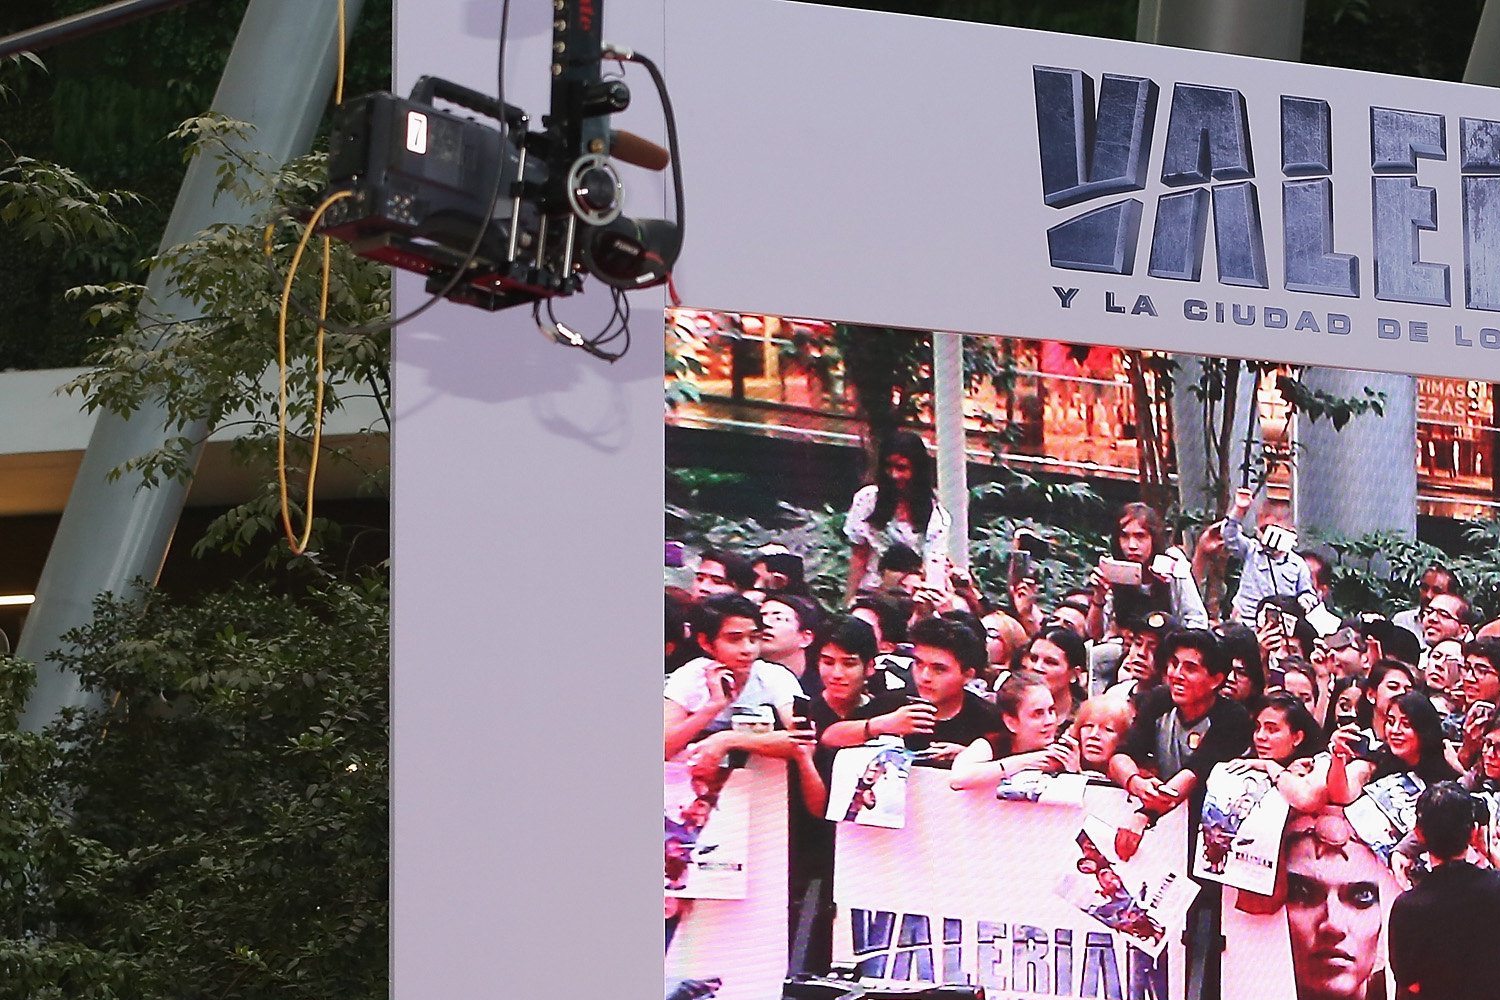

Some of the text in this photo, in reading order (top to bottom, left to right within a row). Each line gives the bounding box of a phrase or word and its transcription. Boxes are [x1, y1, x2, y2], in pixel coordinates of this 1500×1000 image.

[1052, 286, 1080, 309] Y
[1105, 291, 1159, 318] LA
[1183, 299, 1352, 335] CIUDAD
[1377, 318, 1430, 343] DE
[1417, 379, 1466, 396] TIMAS
[1417, 397, 1468, 417] EZAS
